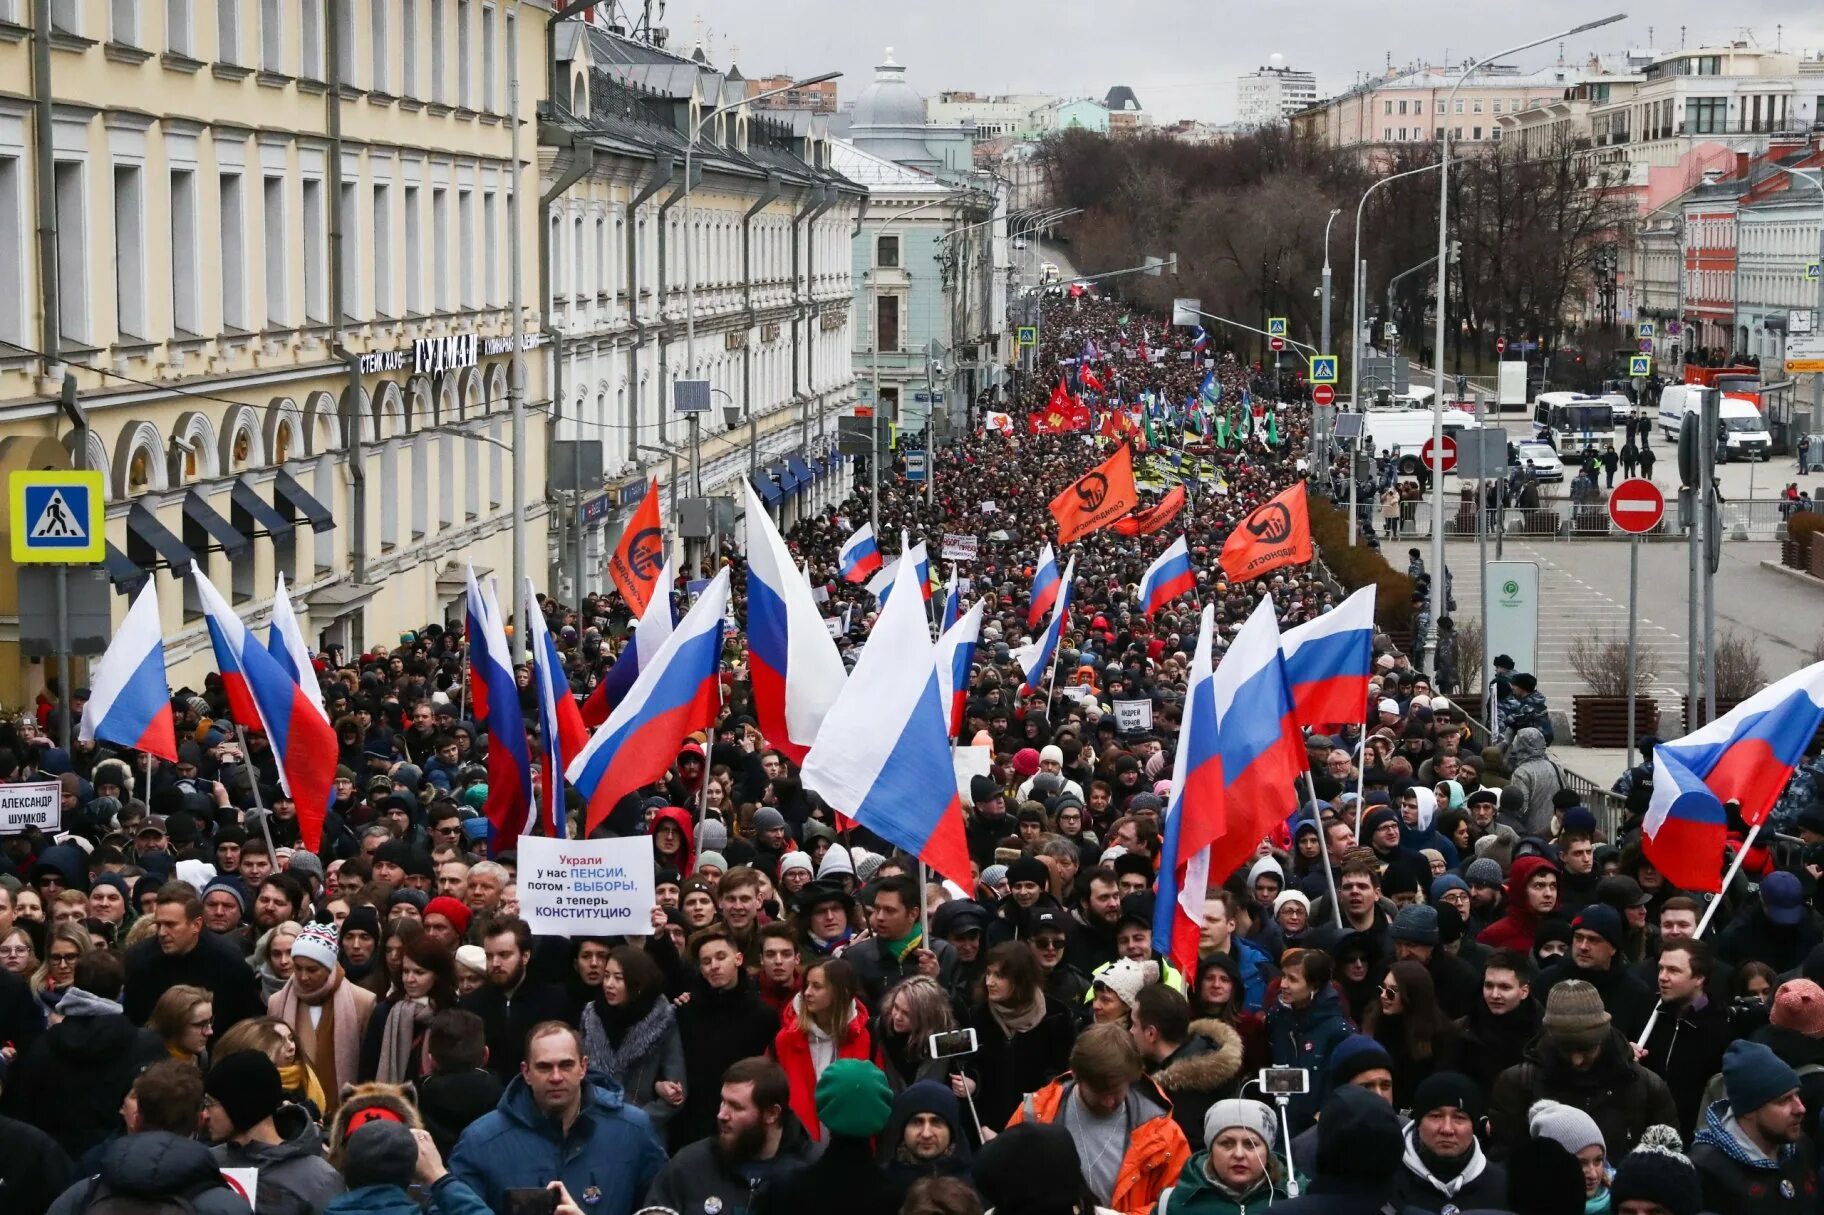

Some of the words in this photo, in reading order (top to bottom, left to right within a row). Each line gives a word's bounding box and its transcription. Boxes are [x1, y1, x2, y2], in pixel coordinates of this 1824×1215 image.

[361, 353, 383, 374] СТЕЙК
[385, 351, 403, 370] ХАУС
[1121, 708, 1141, 717] АНДРЕЙ
[2, 796, 52, 809] АЛЕКСАНДР
[9, 812, 47, 824] ШУМКОВ
[560, 855, 602, 867] Украли
[537, 869, 543, 878] у
[547, 869, 567, 878] нас
[571, 868, 627, 878] ПЕНСИИ,
[528, 881, 563, 891] потом
[574, 881, 638, 891] ВЫБОРЫ,
[556, 896, 562, 904] а
[566, 896, 608, 906] теперь
[536, 907, 631, 919] КОНСТИТУЦИЮ
